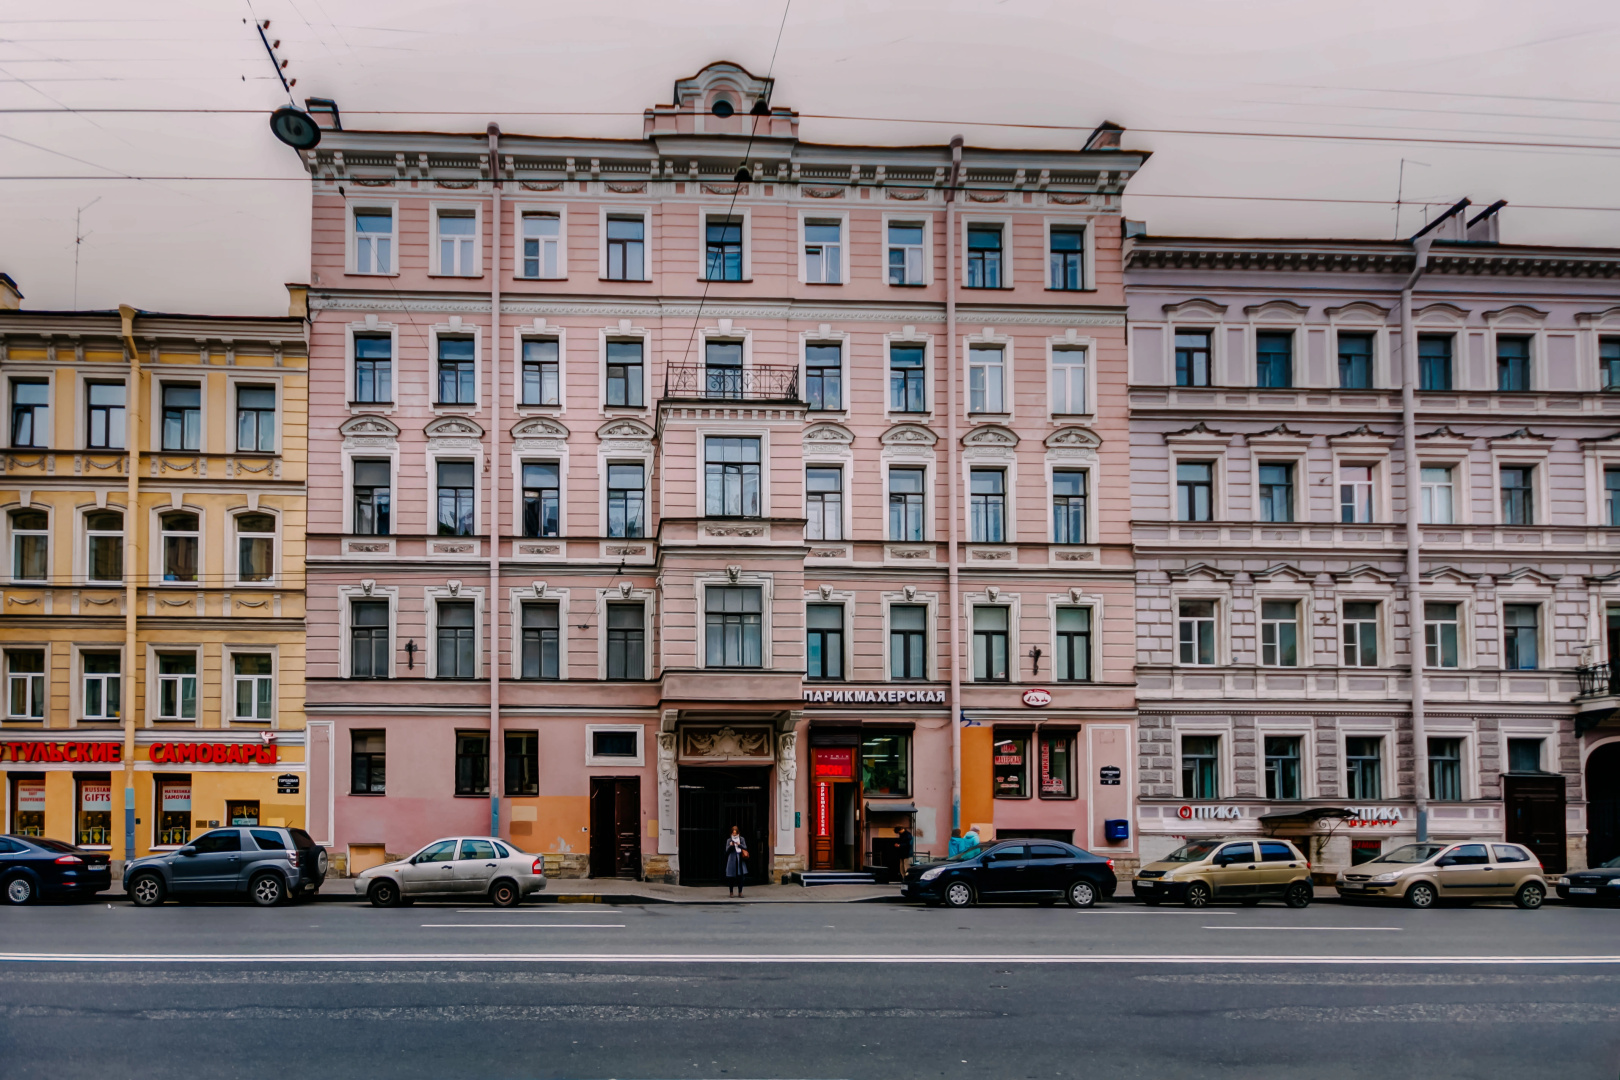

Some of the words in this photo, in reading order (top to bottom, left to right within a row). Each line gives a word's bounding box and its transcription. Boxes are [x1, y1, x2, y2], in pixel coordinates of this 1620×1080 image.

[803, 690, 946, 702] ПАРИКМАХЕРСКАЯ
[7, 742, 121, 762] ТУЛЬСКИЕ
[149, 743, 277, 764] САМОВАРЫ
[84, 793, 111, 802] GIFTS
[1177, 805, 1241, 819] ОПТИКА
